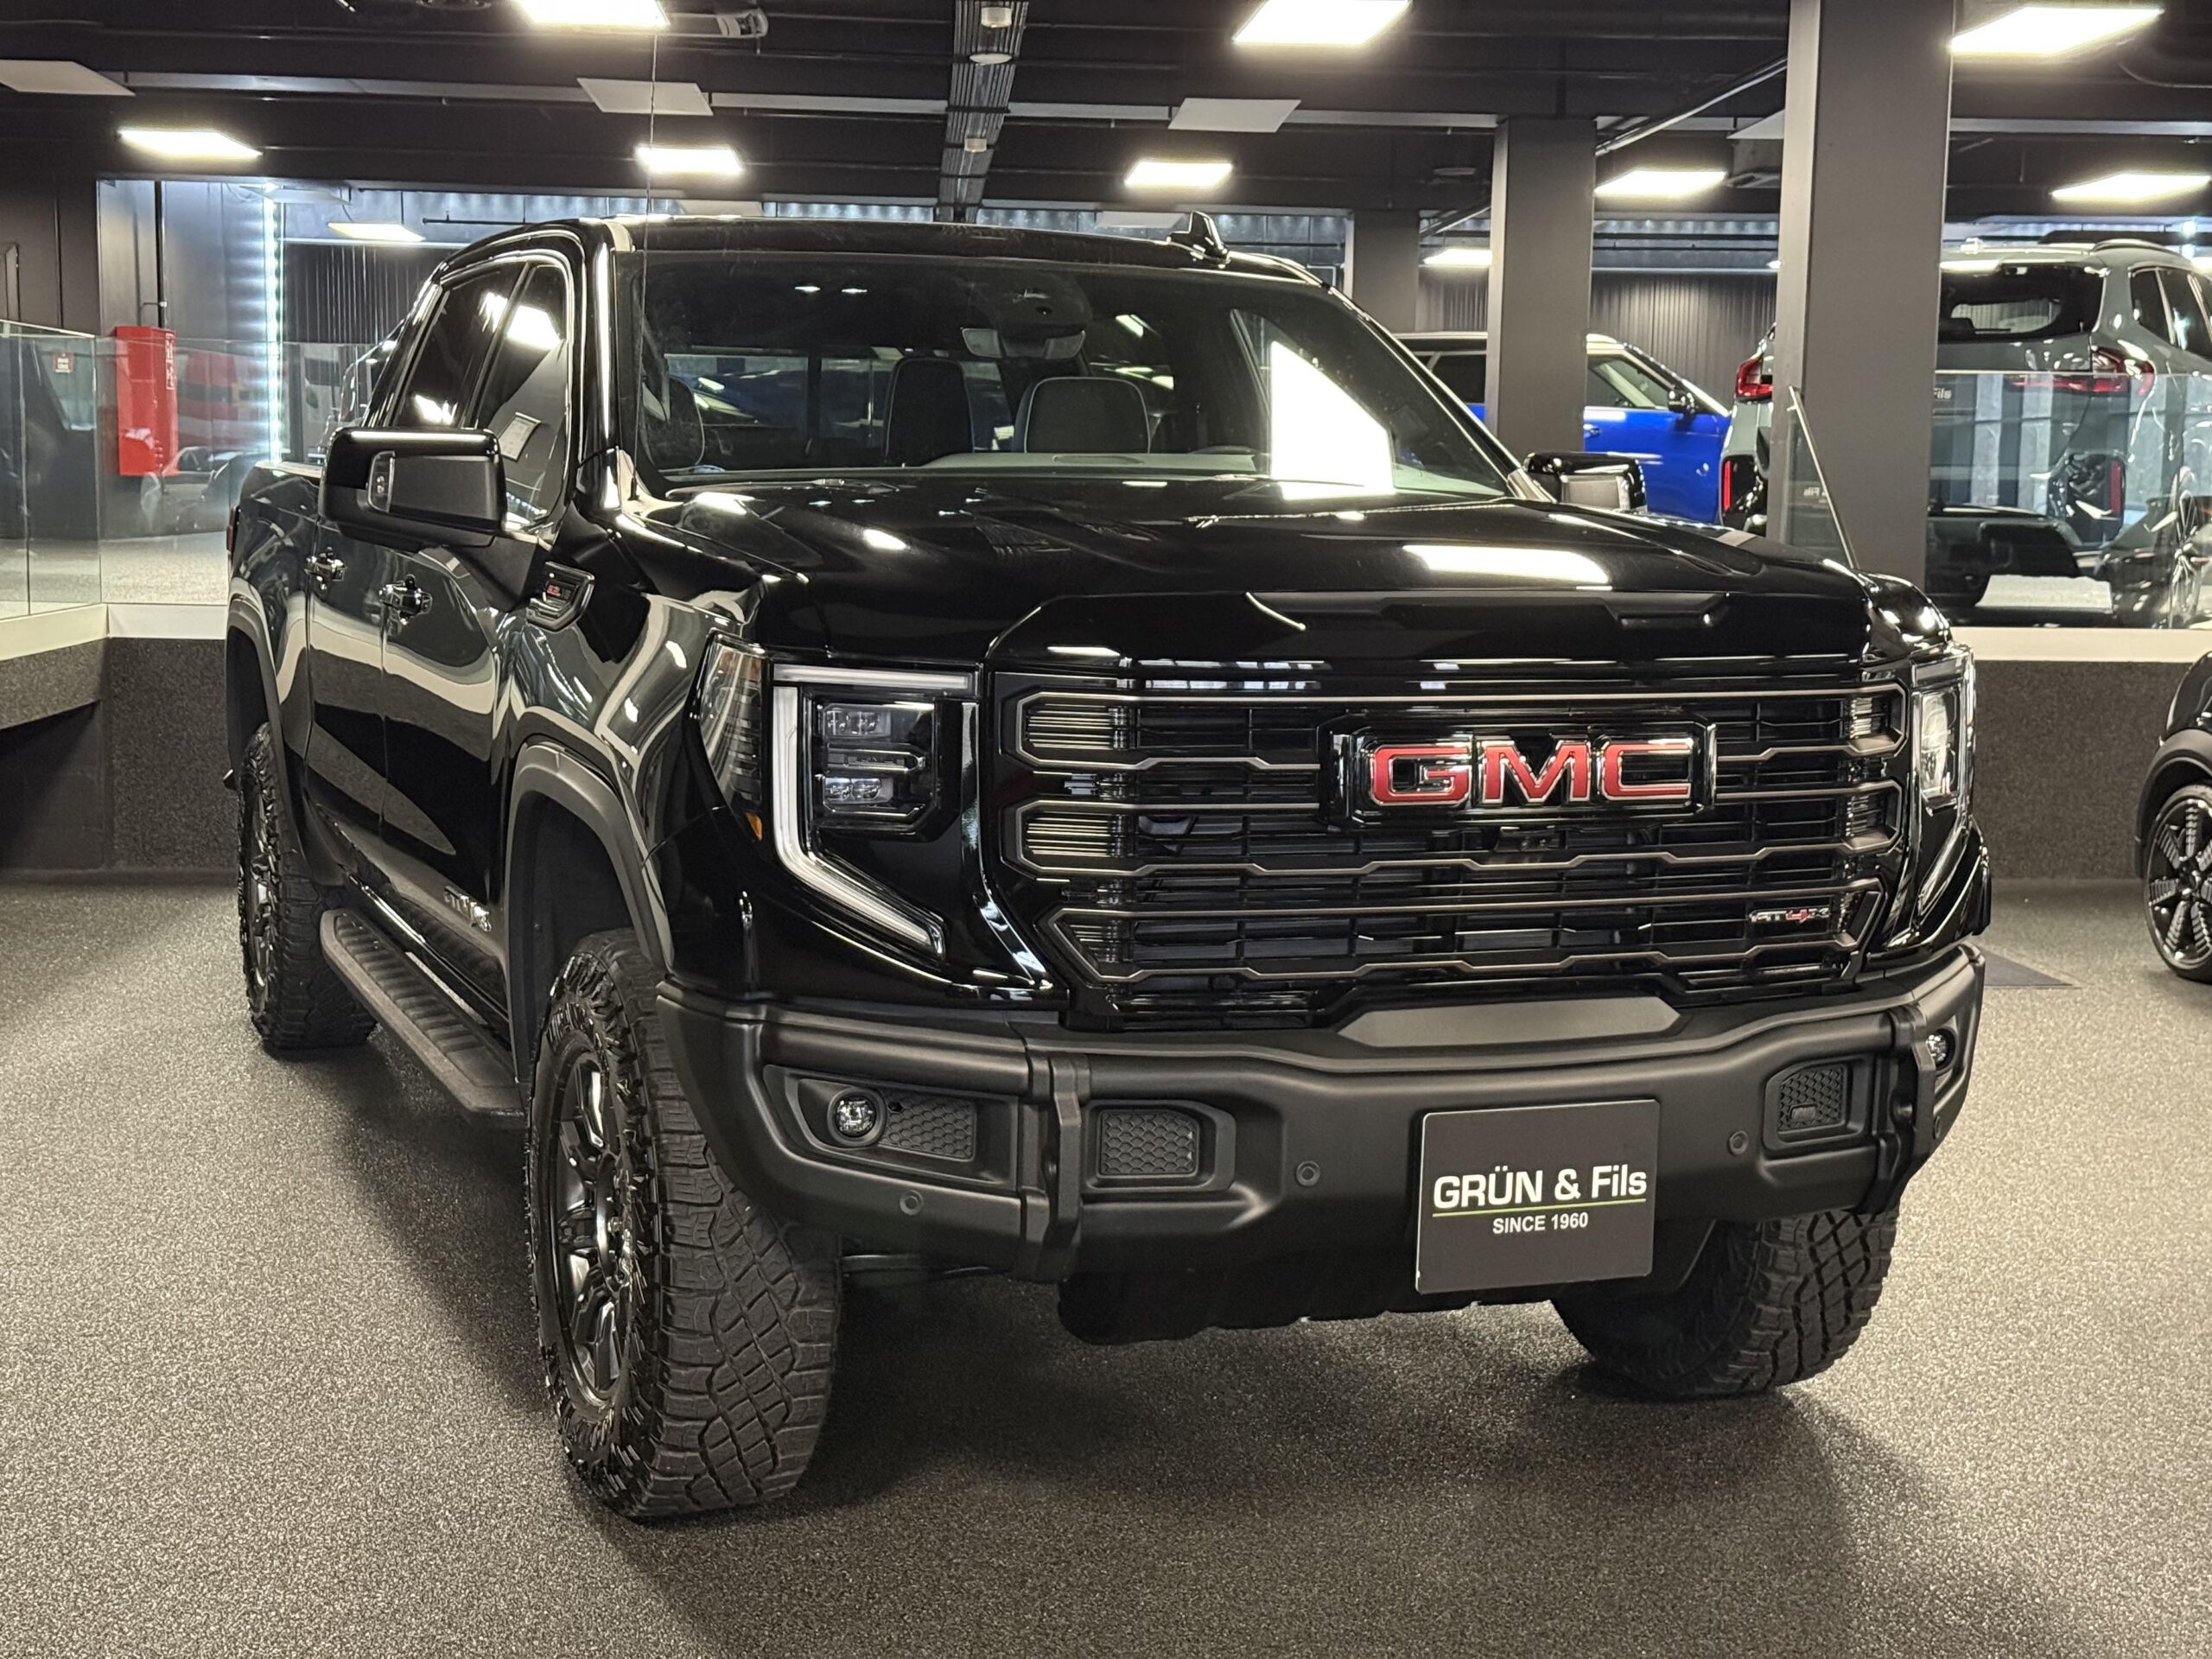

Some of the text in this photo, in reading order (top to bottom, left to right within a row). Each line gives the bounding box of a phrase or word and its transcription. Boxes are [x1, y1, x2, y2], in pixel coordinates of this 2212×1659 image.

[1370, 738, 1692, 805] GMC
[1433, 1164, 1647, 1210] GRÜN & Fils
[1492, 1211, 1589, 1235] SINCE 1960
